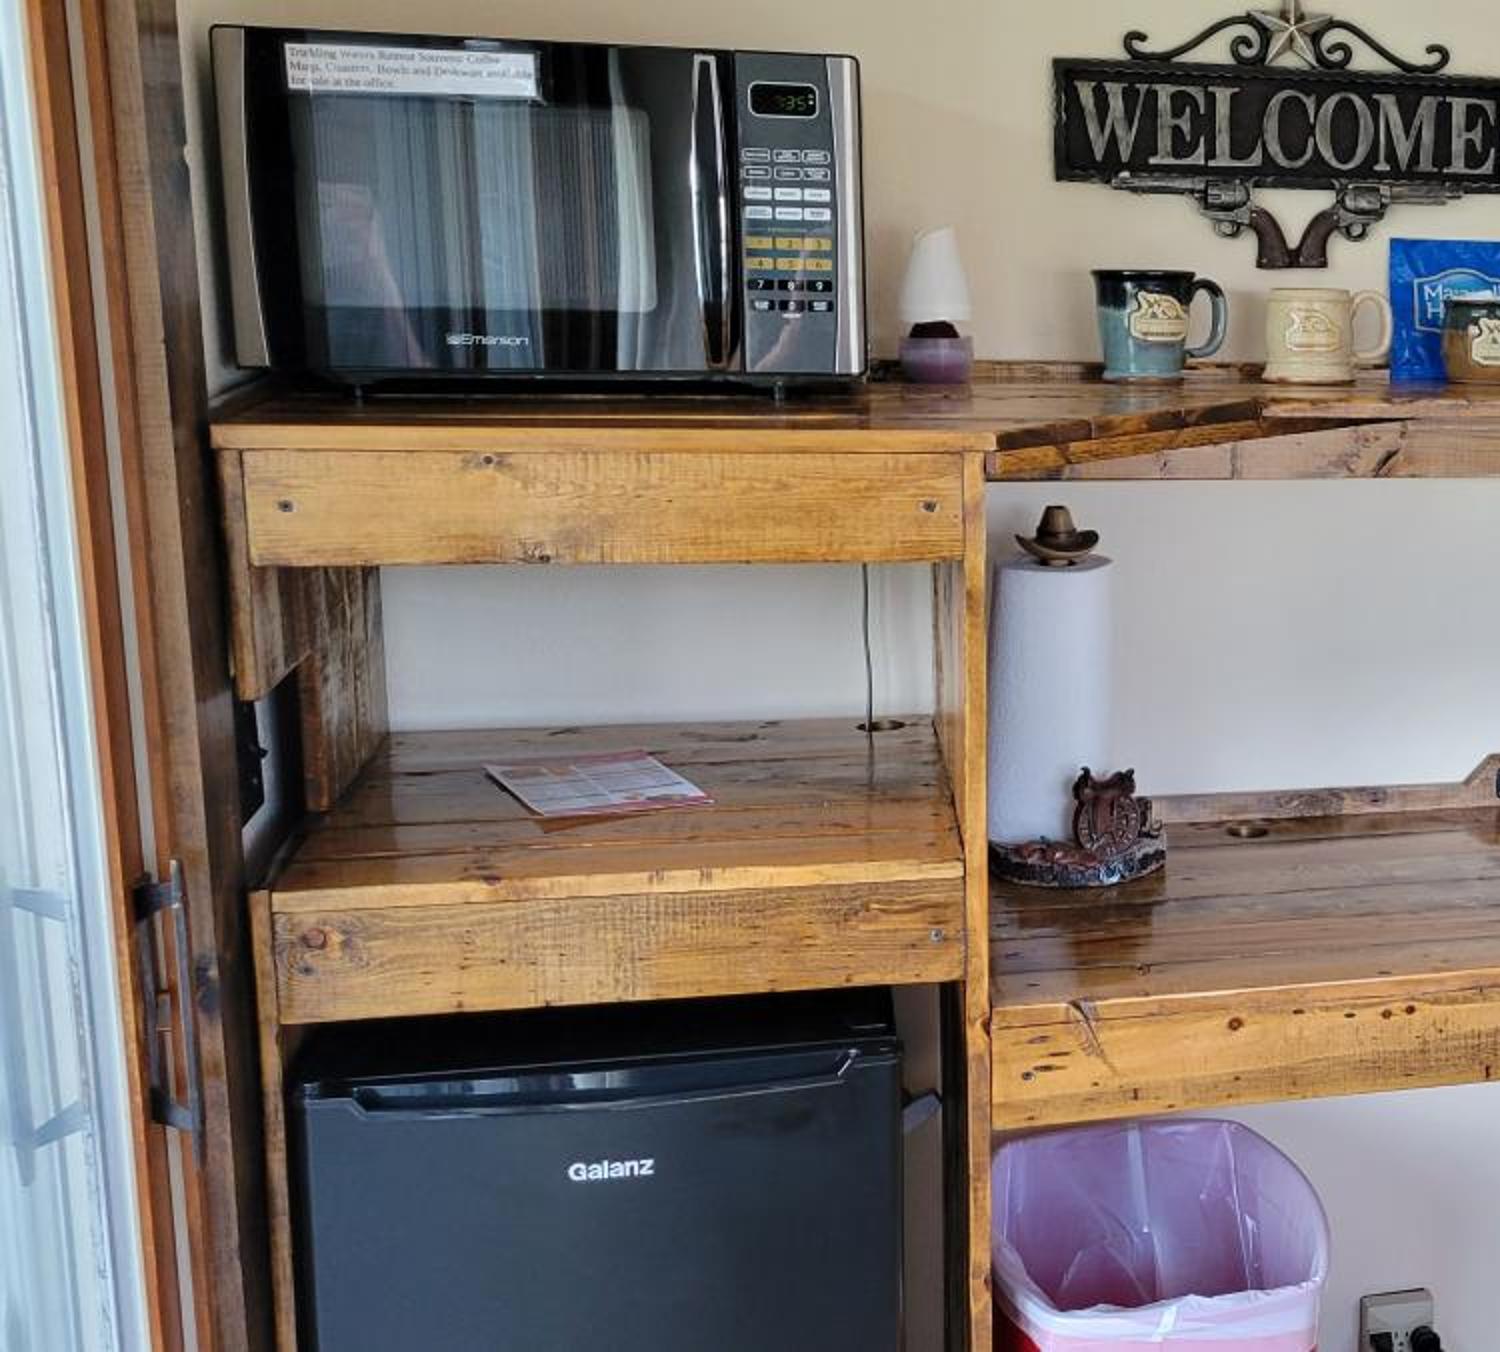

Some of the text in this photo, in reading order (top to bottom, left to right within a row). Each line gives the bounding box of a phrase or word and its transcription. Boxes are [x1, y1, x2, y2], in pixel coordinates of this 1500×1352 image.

[1073, 80, 1497, 176] WELCOME
[758, 280, 823, 291] 7 8 9
[461, 333, 529, 346] Emerson
[567, 1159, 655, 1181] Galanz
